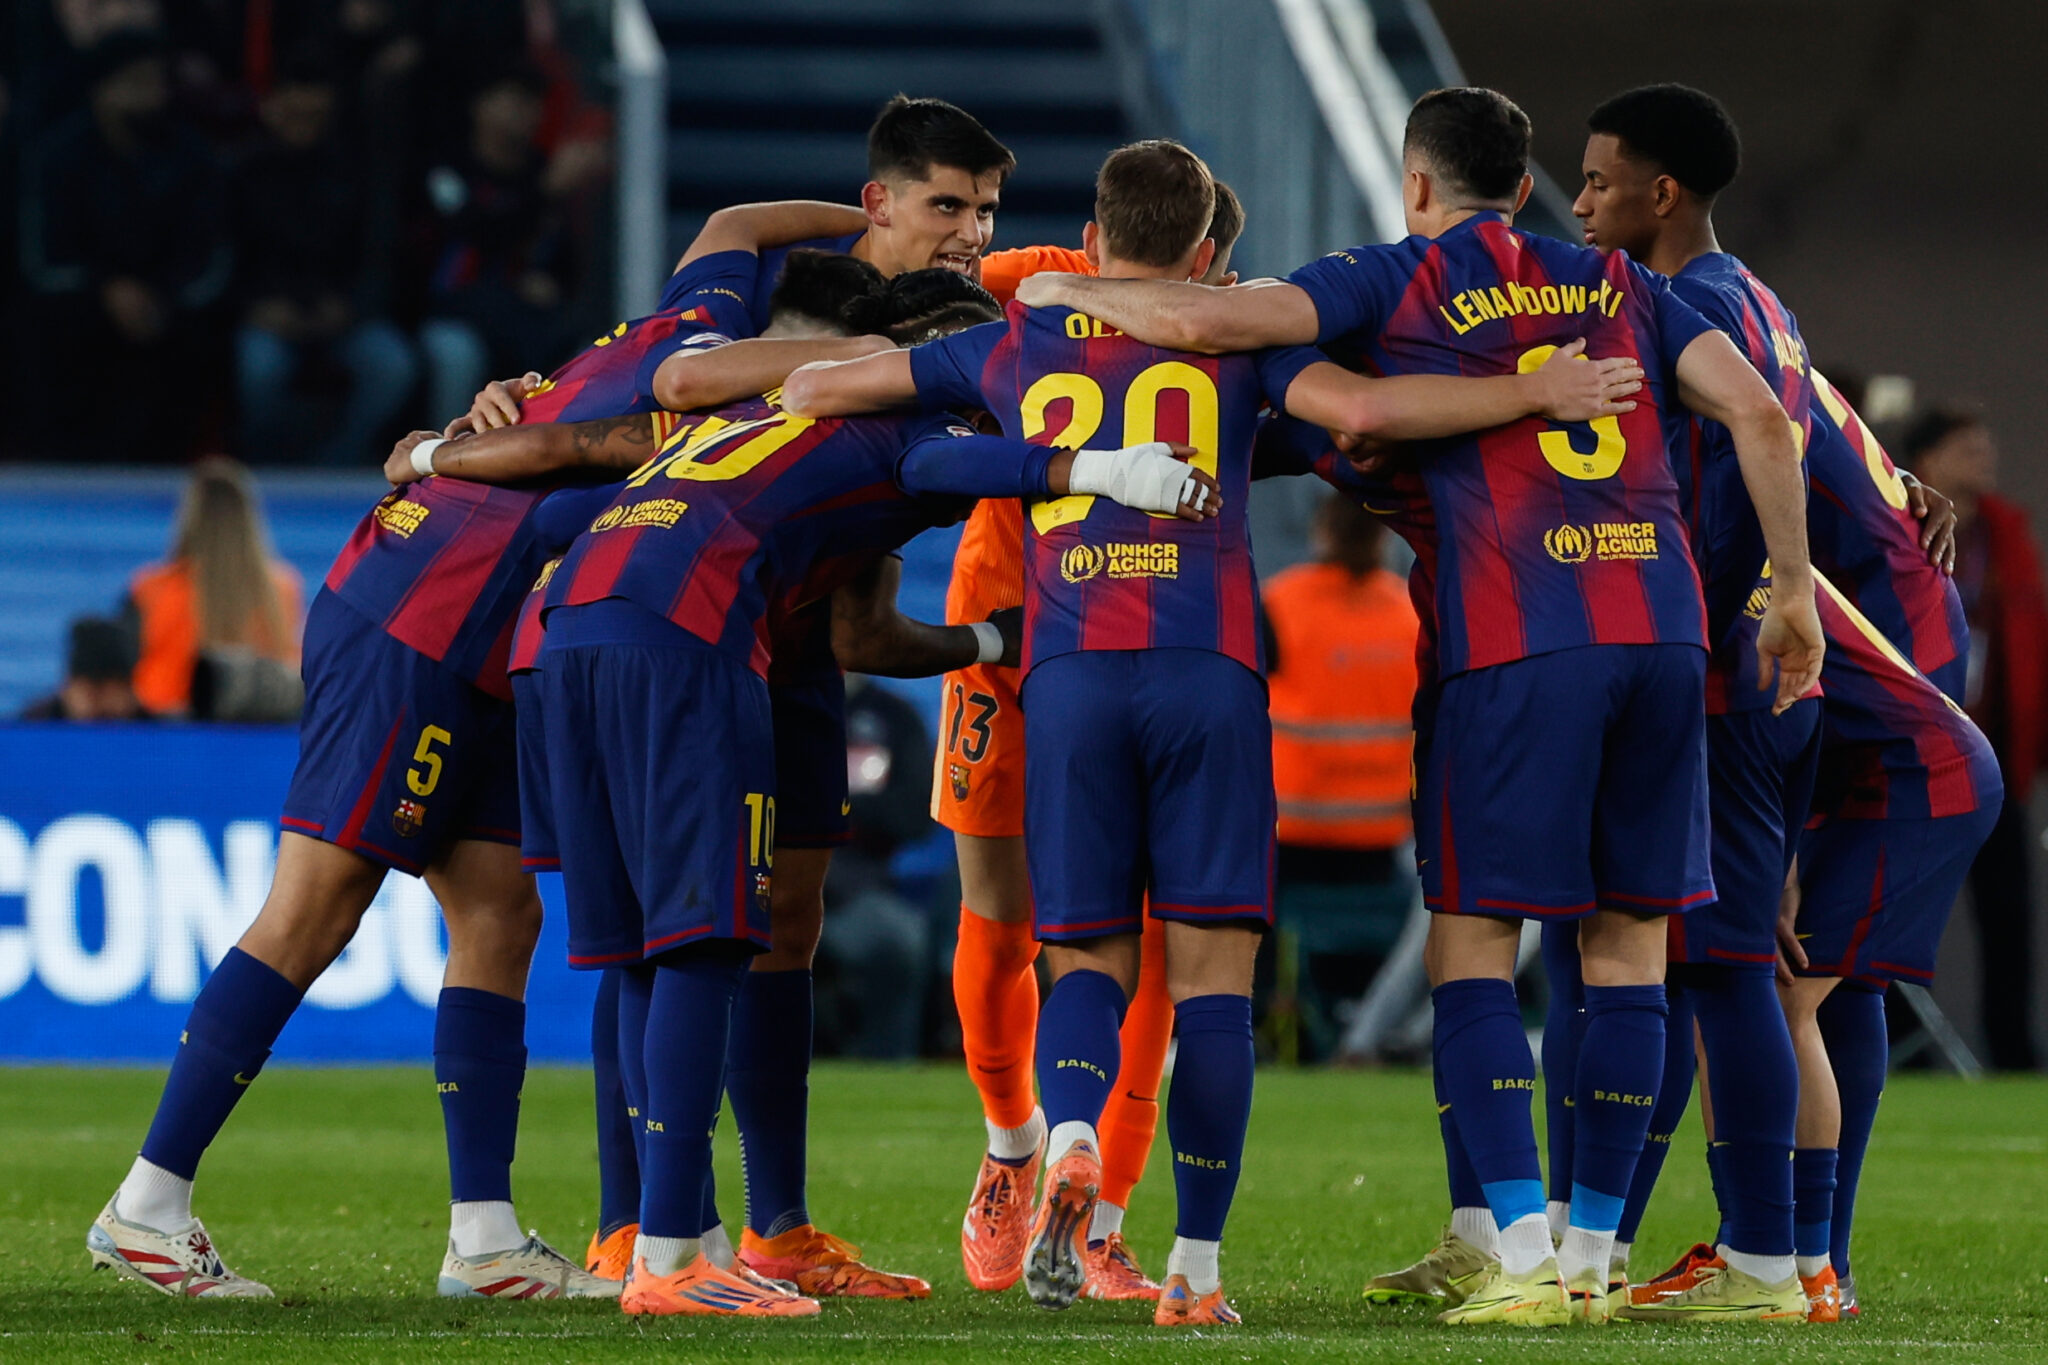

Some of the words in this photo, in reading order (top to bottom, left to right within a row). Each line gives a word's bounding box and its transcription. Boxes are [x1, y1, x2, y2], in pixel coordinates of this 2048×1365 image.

[1020, 360, 1219, 537] 20
[631, 499, 689, 515] UNHCR
[622, 510, 680, 525] ACNUR
[1593, 522, 1656, 539] UNHCR
[1106, 542, 1179, 558] UNHCR
[1596, 538, 1658, 555] ACNUR
[1107, 557, 1179, 573] ACNUR
[949, 682, 999, 764] 13
[407, 724, 452, 797] 5
[744, 792, 776, 869] 10
[1594, 1090, 1653, 1107] BARÇA
[1177, 1152, 1227, 1170] BARÇA
